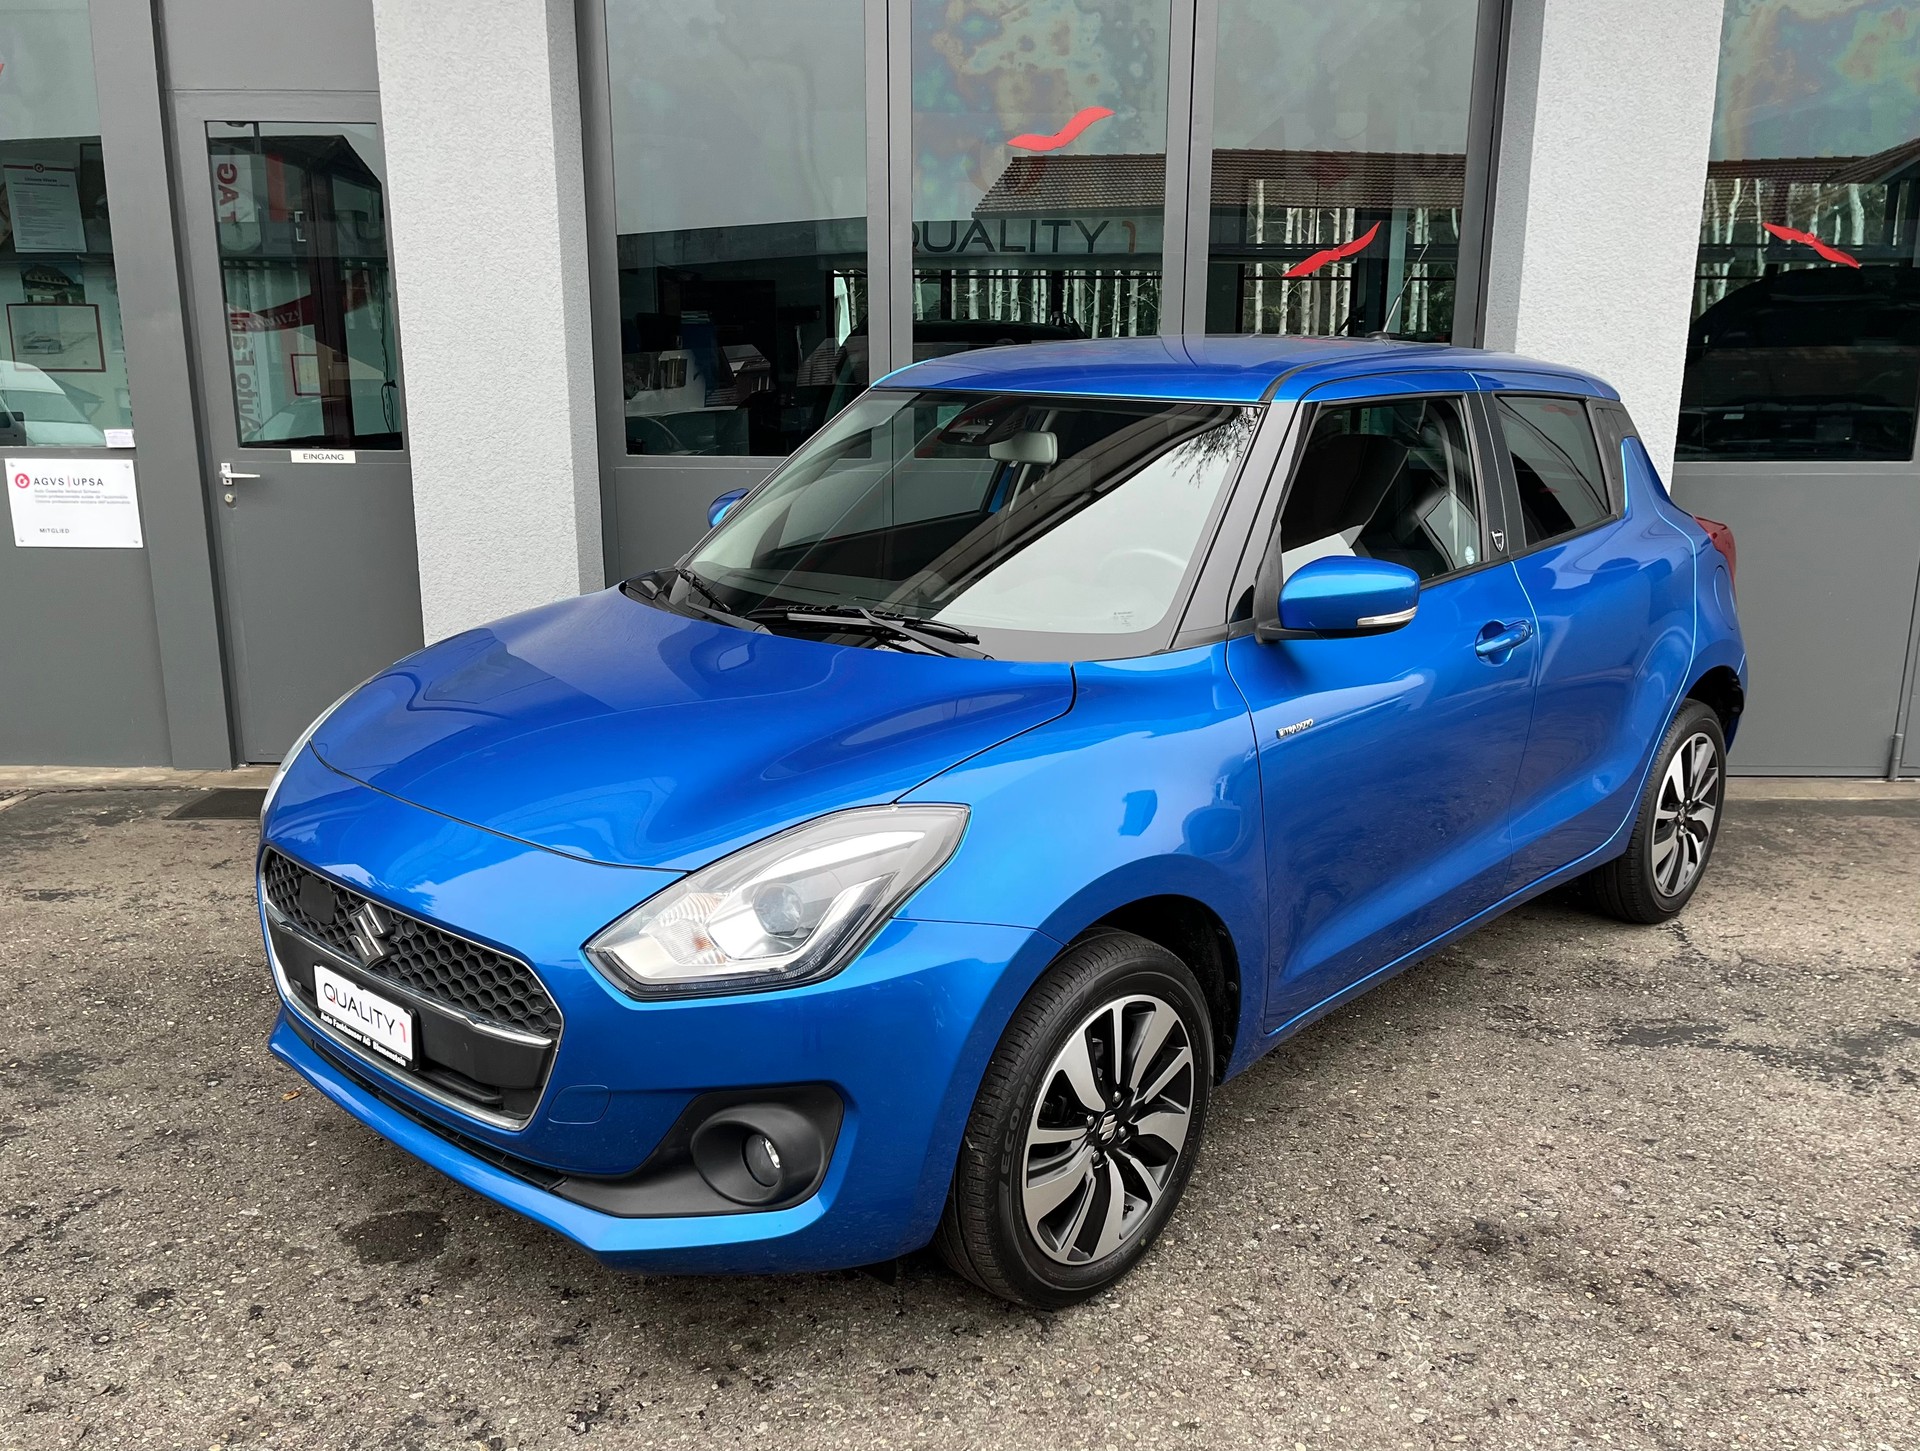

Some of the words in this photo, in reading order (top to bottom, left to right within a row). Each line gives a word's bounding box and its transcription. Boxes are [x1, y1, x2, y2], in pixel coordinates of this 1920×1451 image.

[912, 219, 1110, 253] UALITY
[303, 453, 344, 461] EINGANG
[34, 477, 65, 486] AGVS
[73, 477, 104, 487] UPSA
[323, 982, 396, 1036] QUALITY
[399, 1021, 407, 1043] 1
